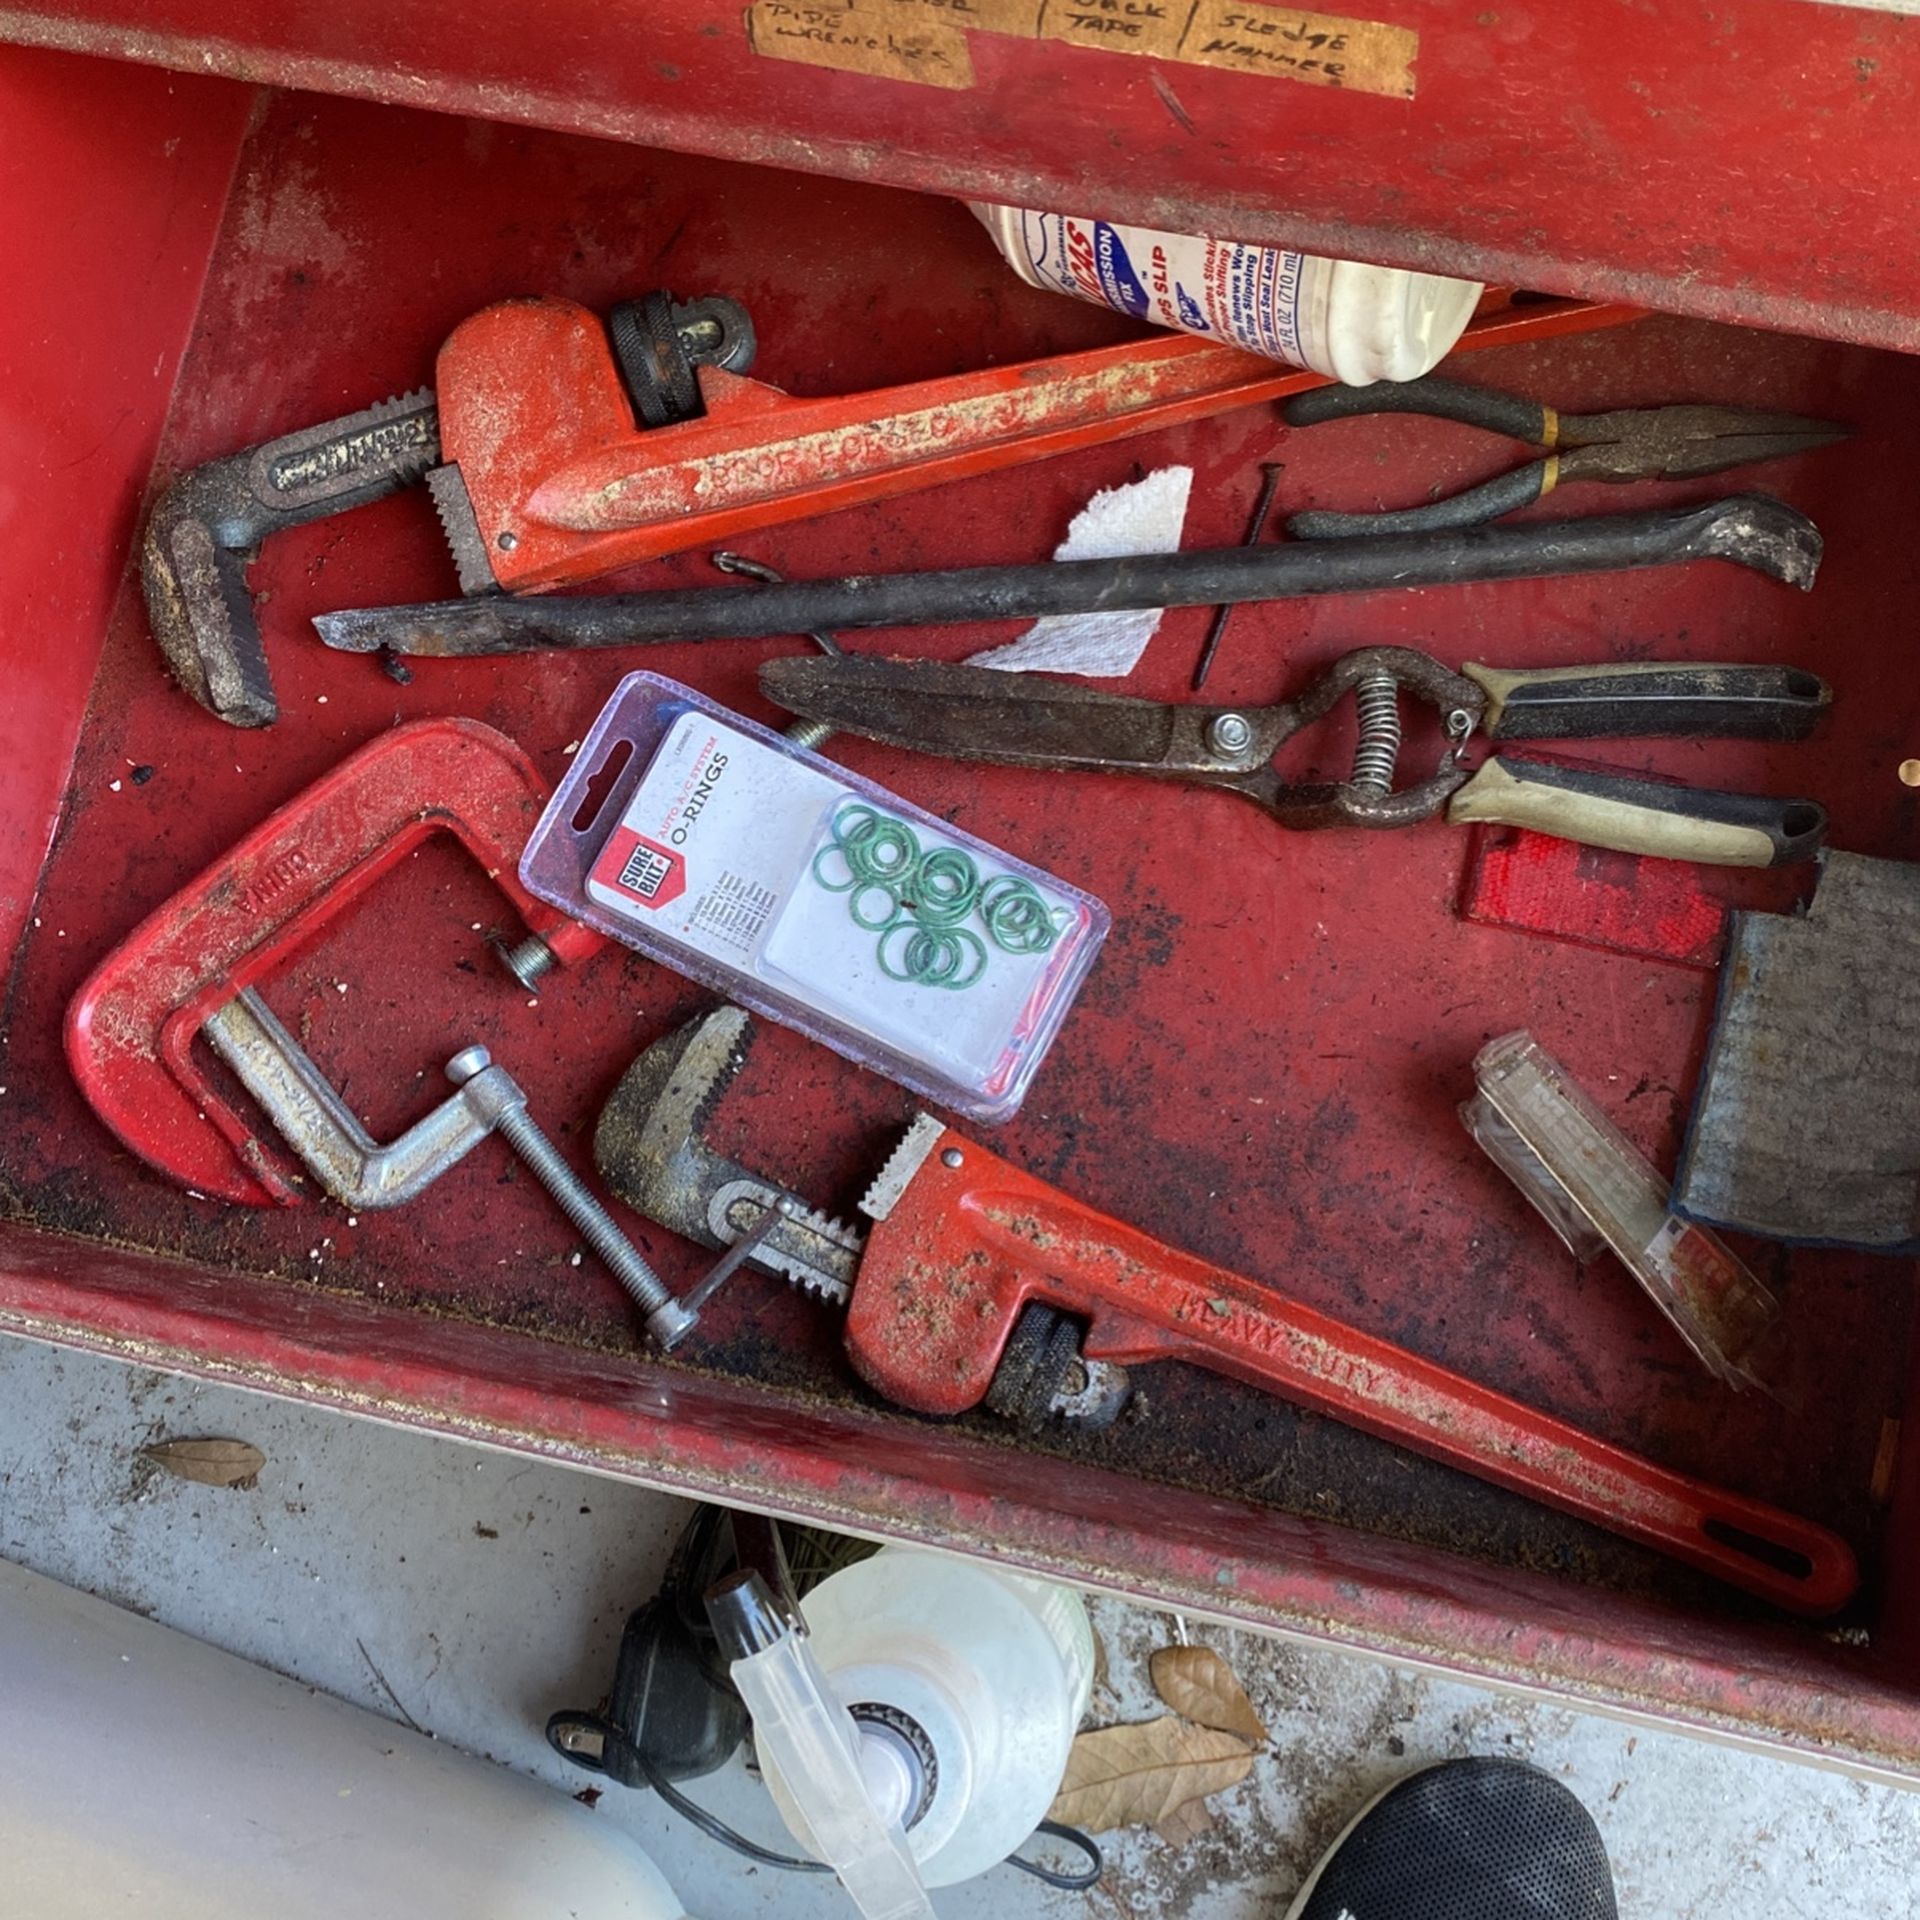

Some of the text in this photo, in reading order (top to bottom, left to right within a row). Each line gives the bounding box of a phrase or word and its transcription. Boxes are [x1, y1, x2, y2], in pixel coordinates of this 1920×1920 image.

[1065, 12, 1142, 37] TAPE
[1152, 244, 1169, 294] SLIP
[1216, 248, 1231, 299] Shifting
[1242, 254, 1258, 311] Slipping
[1262, 248, 1276, 281] Leak
[1119, 281, 1136, 303] FIX
[1232, 274, 1243, 323] Renews
[1260, 283, 1271, 309] Seal
[1246, 313, 1257, 337] Stop
[1260, 310, 1273, 334] Most
[658, 736, 718, 838] AUTO A/C SYSTEM
[670, 751, 728, 845] O-RINGS
[622, 847, 654, 887] SURE
[637, 864, 664, 895] BILT
